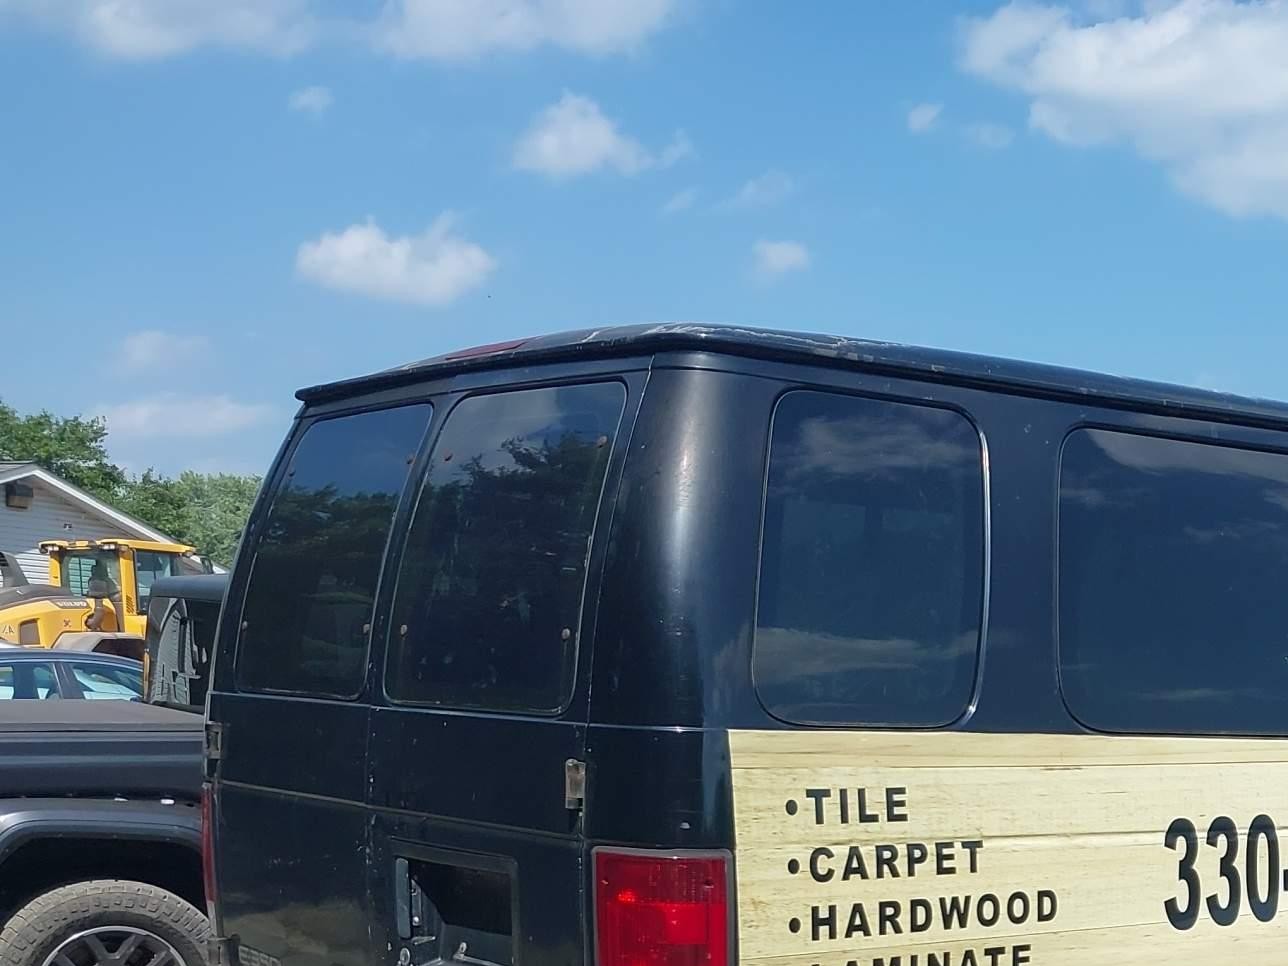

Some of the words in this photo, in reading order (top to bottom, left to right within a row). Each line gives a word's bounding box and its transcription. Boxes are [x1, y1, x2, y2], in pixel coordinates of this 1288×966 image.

[804, 786, 909, 825] TILE
[808, 839, 984, 884] CARPET
[810, 889, 1059, 942] HARDWOOD
